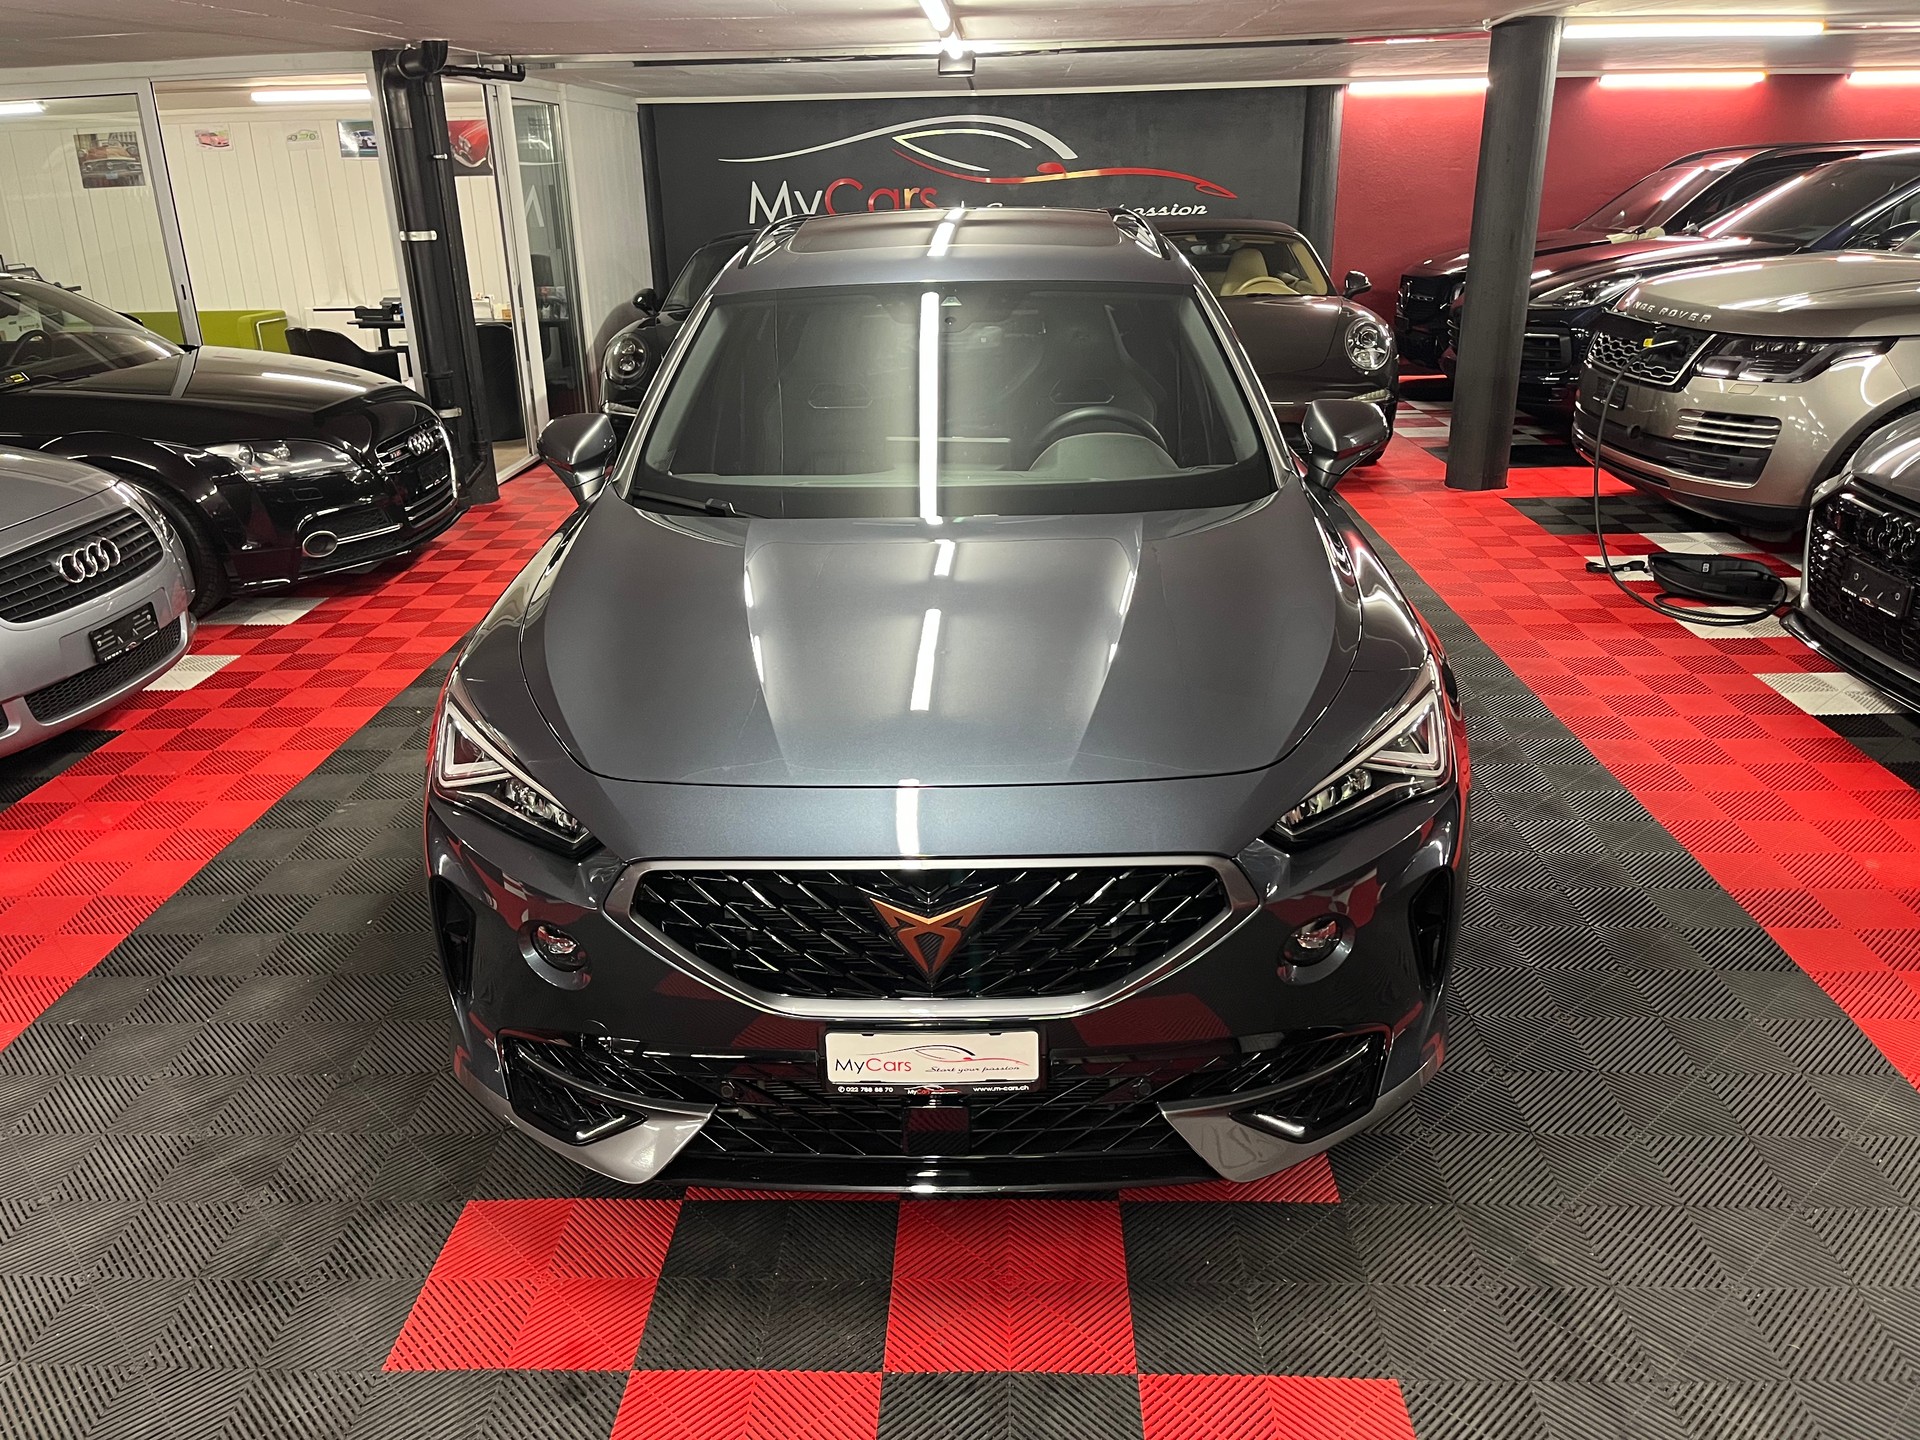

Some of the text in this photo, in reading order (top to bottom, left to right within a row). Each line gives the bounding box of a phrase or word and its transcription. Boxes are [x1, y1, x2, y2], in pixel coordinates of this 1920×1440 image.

[749, 177, 937, 224] MyCars
[1120, 203, 1208, 217] assion
[1659, 307, 1712, 323] ROVER
[835, 1057, 912, 1074] MyCars
